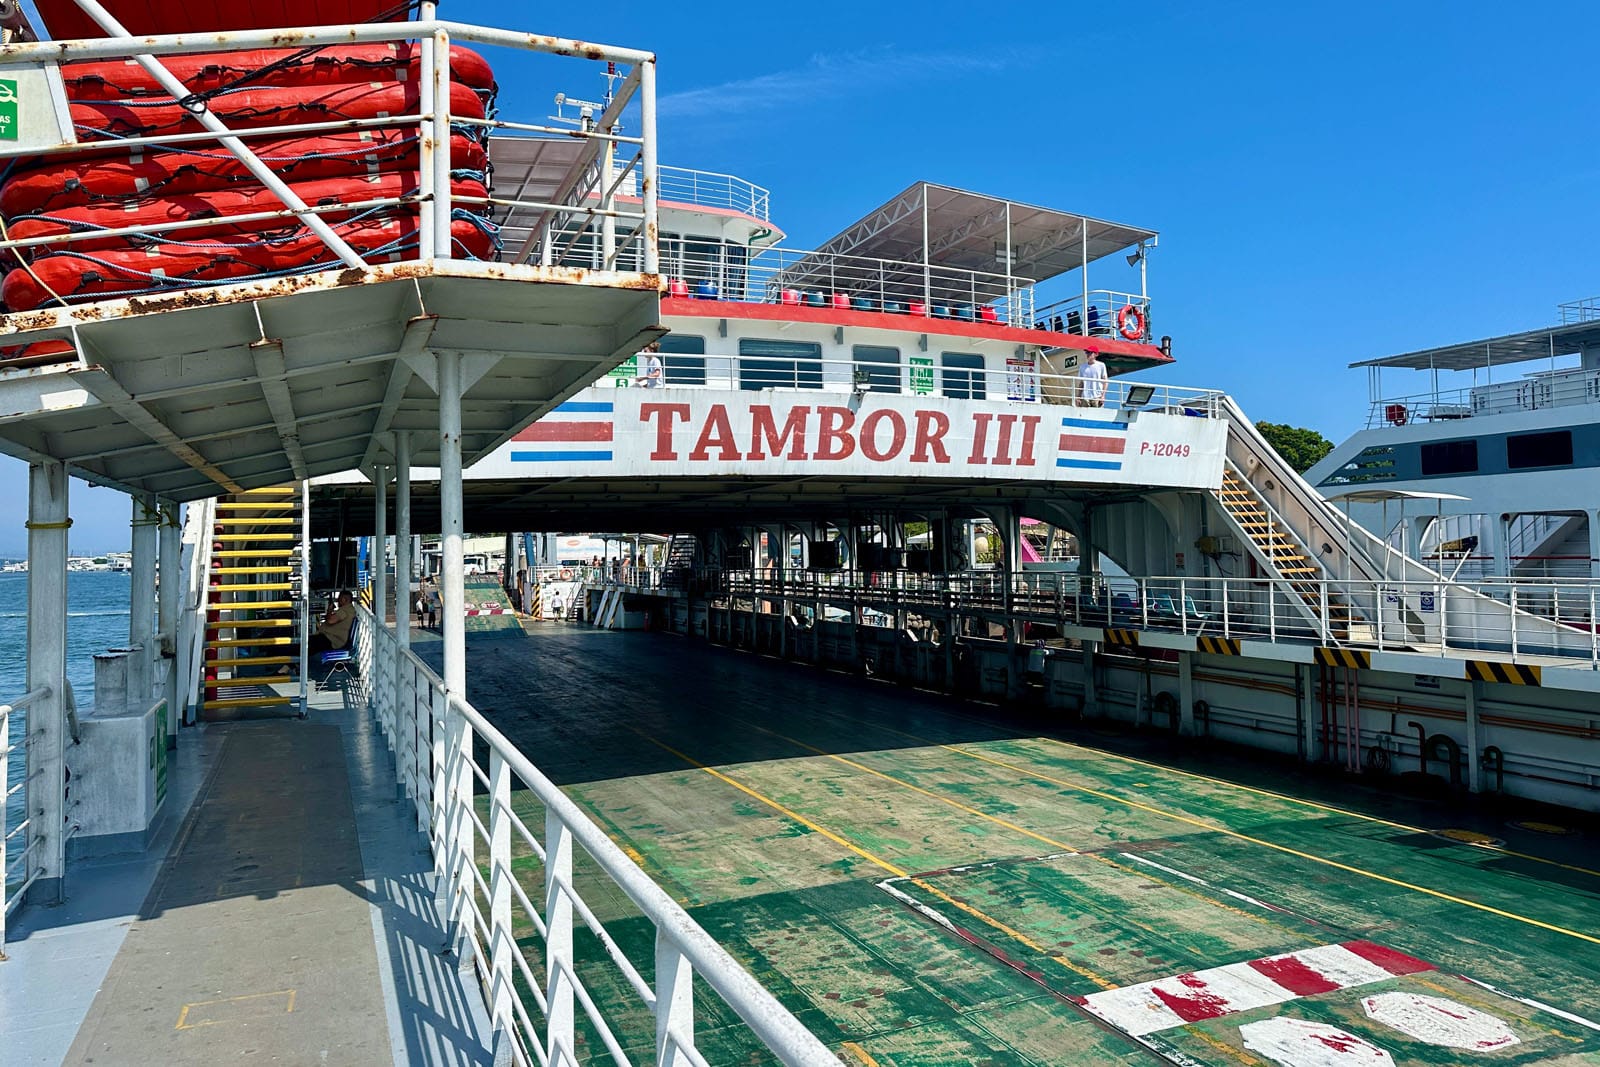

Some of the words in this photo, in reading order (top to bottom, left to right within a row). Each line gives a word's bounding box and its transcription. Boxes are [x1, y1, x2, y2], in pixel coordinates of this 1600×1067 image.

[639, 402, 951, 464] TAMBOR
[967, 413, 1042, 466] III
[1140, 441, 1190, 458] P-12049
